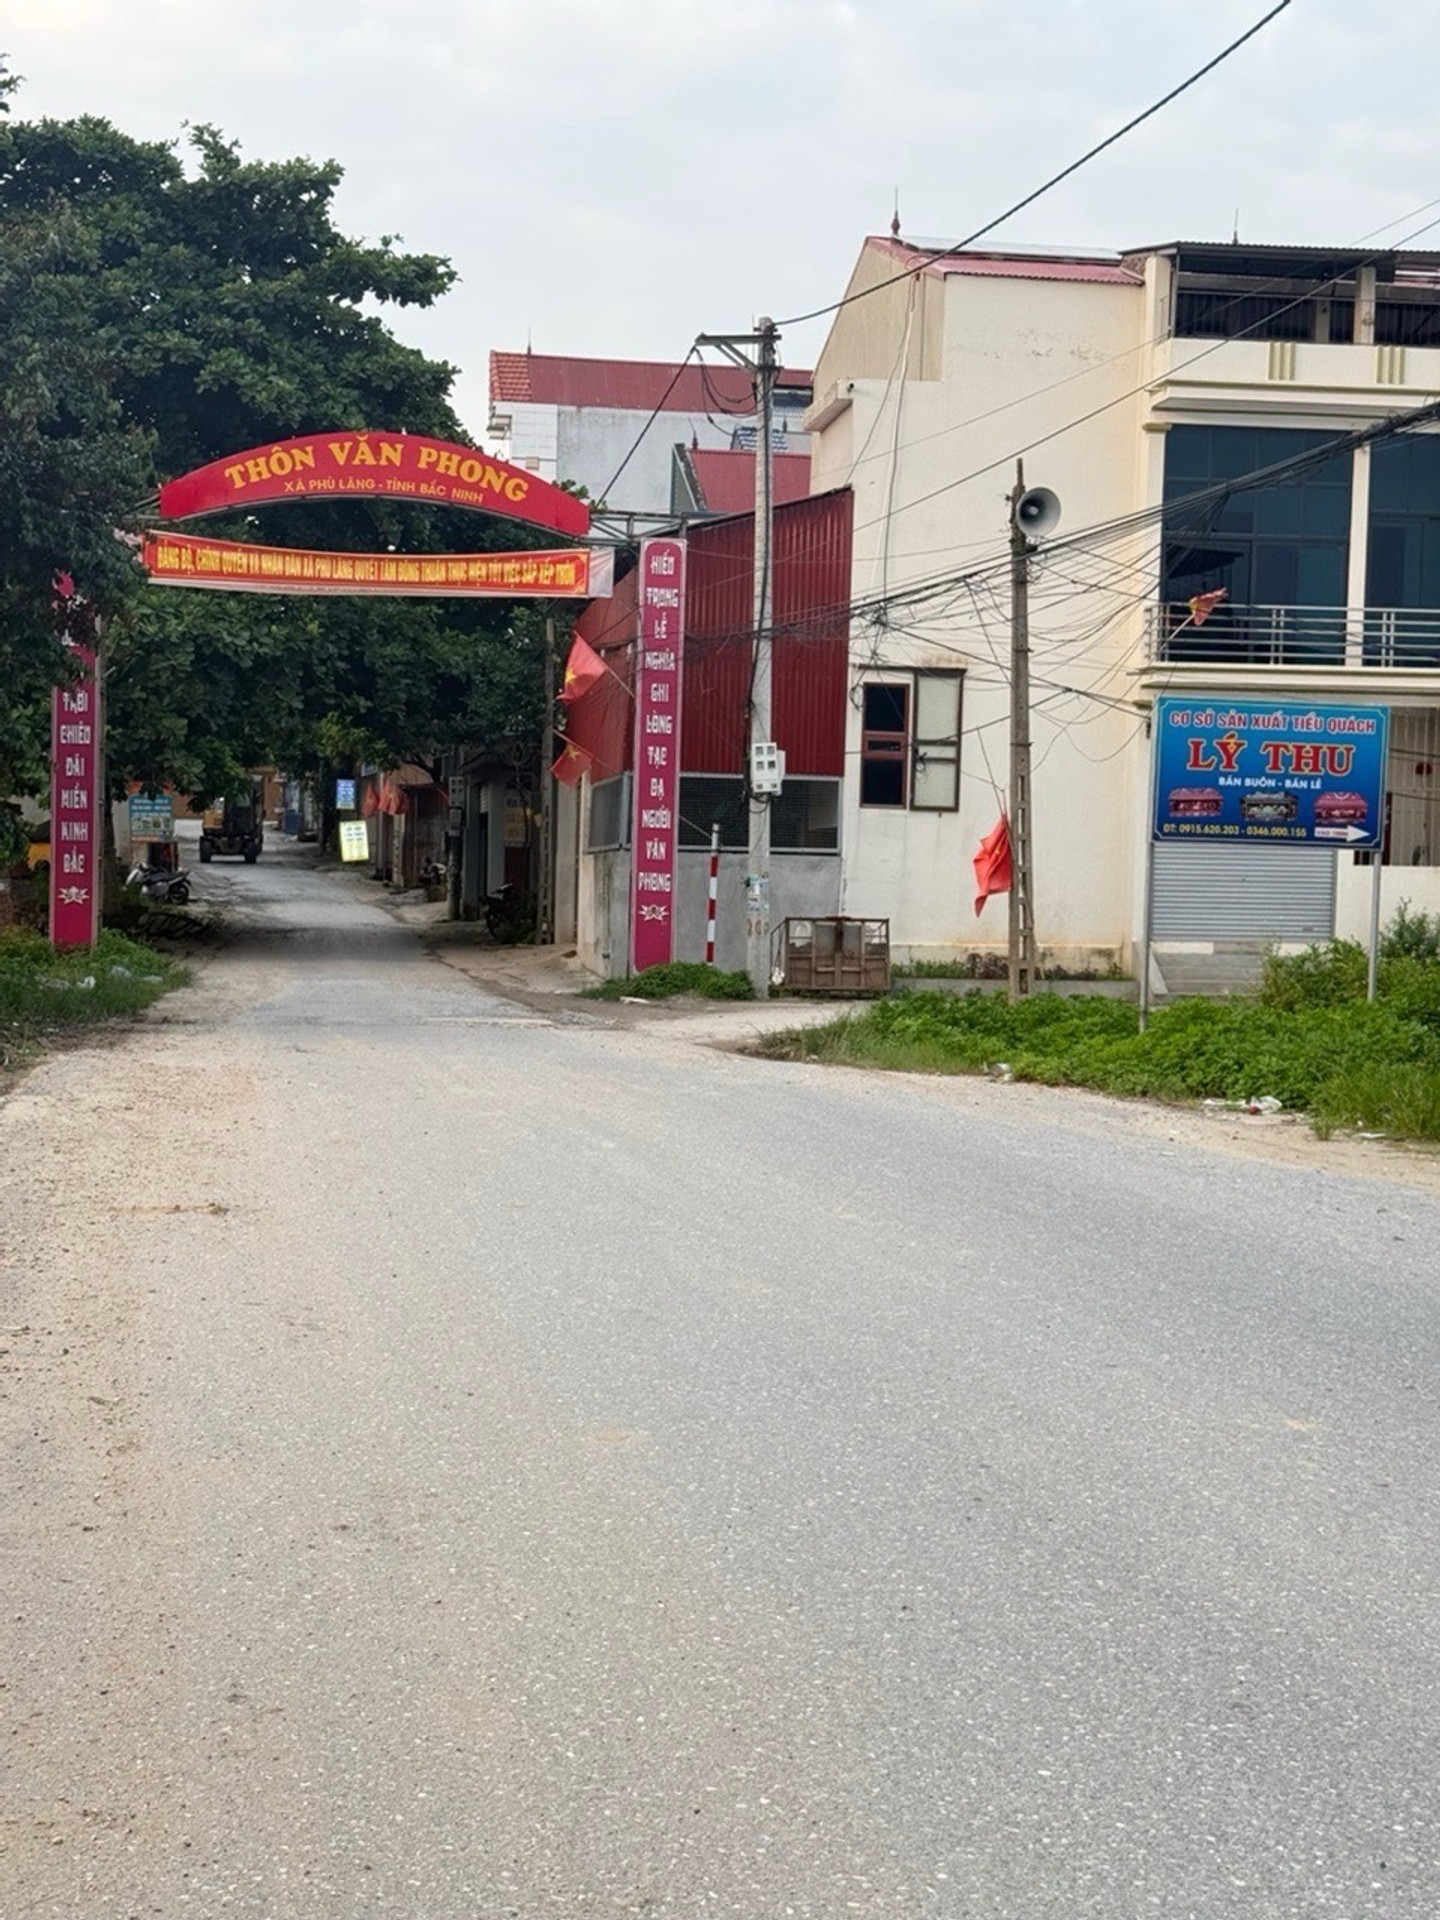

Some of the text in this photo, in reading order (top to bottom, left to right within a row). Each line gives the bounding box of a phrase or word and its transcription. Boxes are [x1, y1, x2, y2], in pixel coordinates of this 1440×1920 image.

[225, 434, 529, 502] THÔN VĂN PHONG
[284, 478, 306, 493] XÃ
[309, 475, 336, 489] PHÙ
[386, 476, 416, 492] TỈNH
[420, 479, 446, 497] BẮC
[451, 487, 484, 504] NINH
[646, 587, 678, 608] TRỌNG
[651, 683, 669, 702] GHI
[1170, 710, 1192, 728] CƠ
[1194, 707, 1215, 728] SỞ
[1217, 708, 1247, 730] SẢN
[1251, 709, 1290, 731] XUẤT
[1327, 714, 1376, 735] QUÁCH
[1187, 731, 1355, 776] LÝ THU
[1219, 775, 1242, 787] BÁN
[1244, 776, 1276, 788] BUÔN
[1284, 777, 1308, 789] BÁN
[61, 821, 88, 841] KINH
[645, 838, 666, 861] VĂN
[638, 872, 671, 892] PHONG
